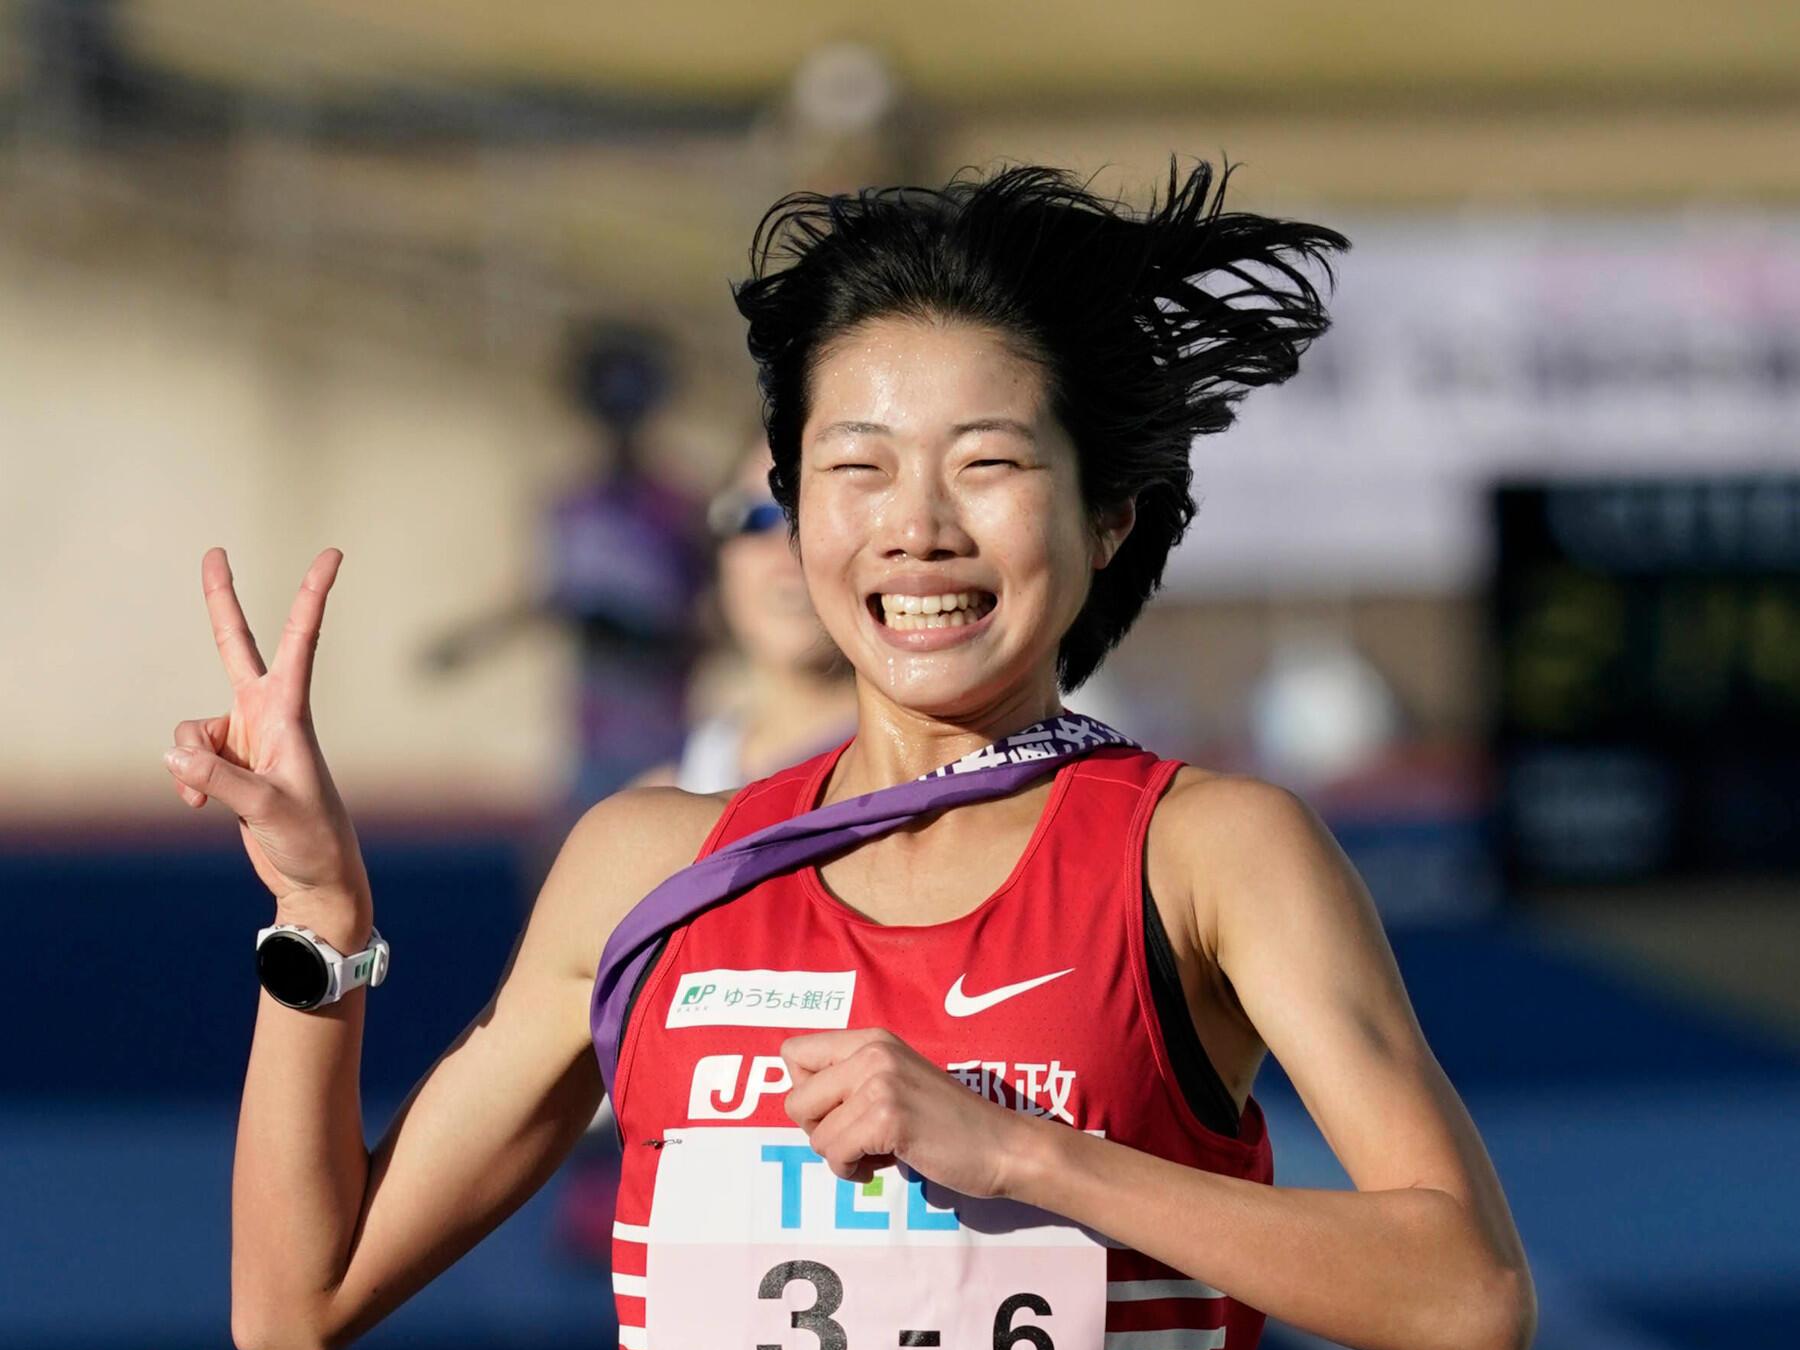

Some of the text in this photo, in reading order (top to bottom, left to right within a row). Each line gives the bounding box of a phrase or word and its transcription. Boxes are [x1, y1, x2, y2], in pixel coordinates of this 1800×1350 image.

[723, 988, 846, 1011] ゆうちょ銀行
